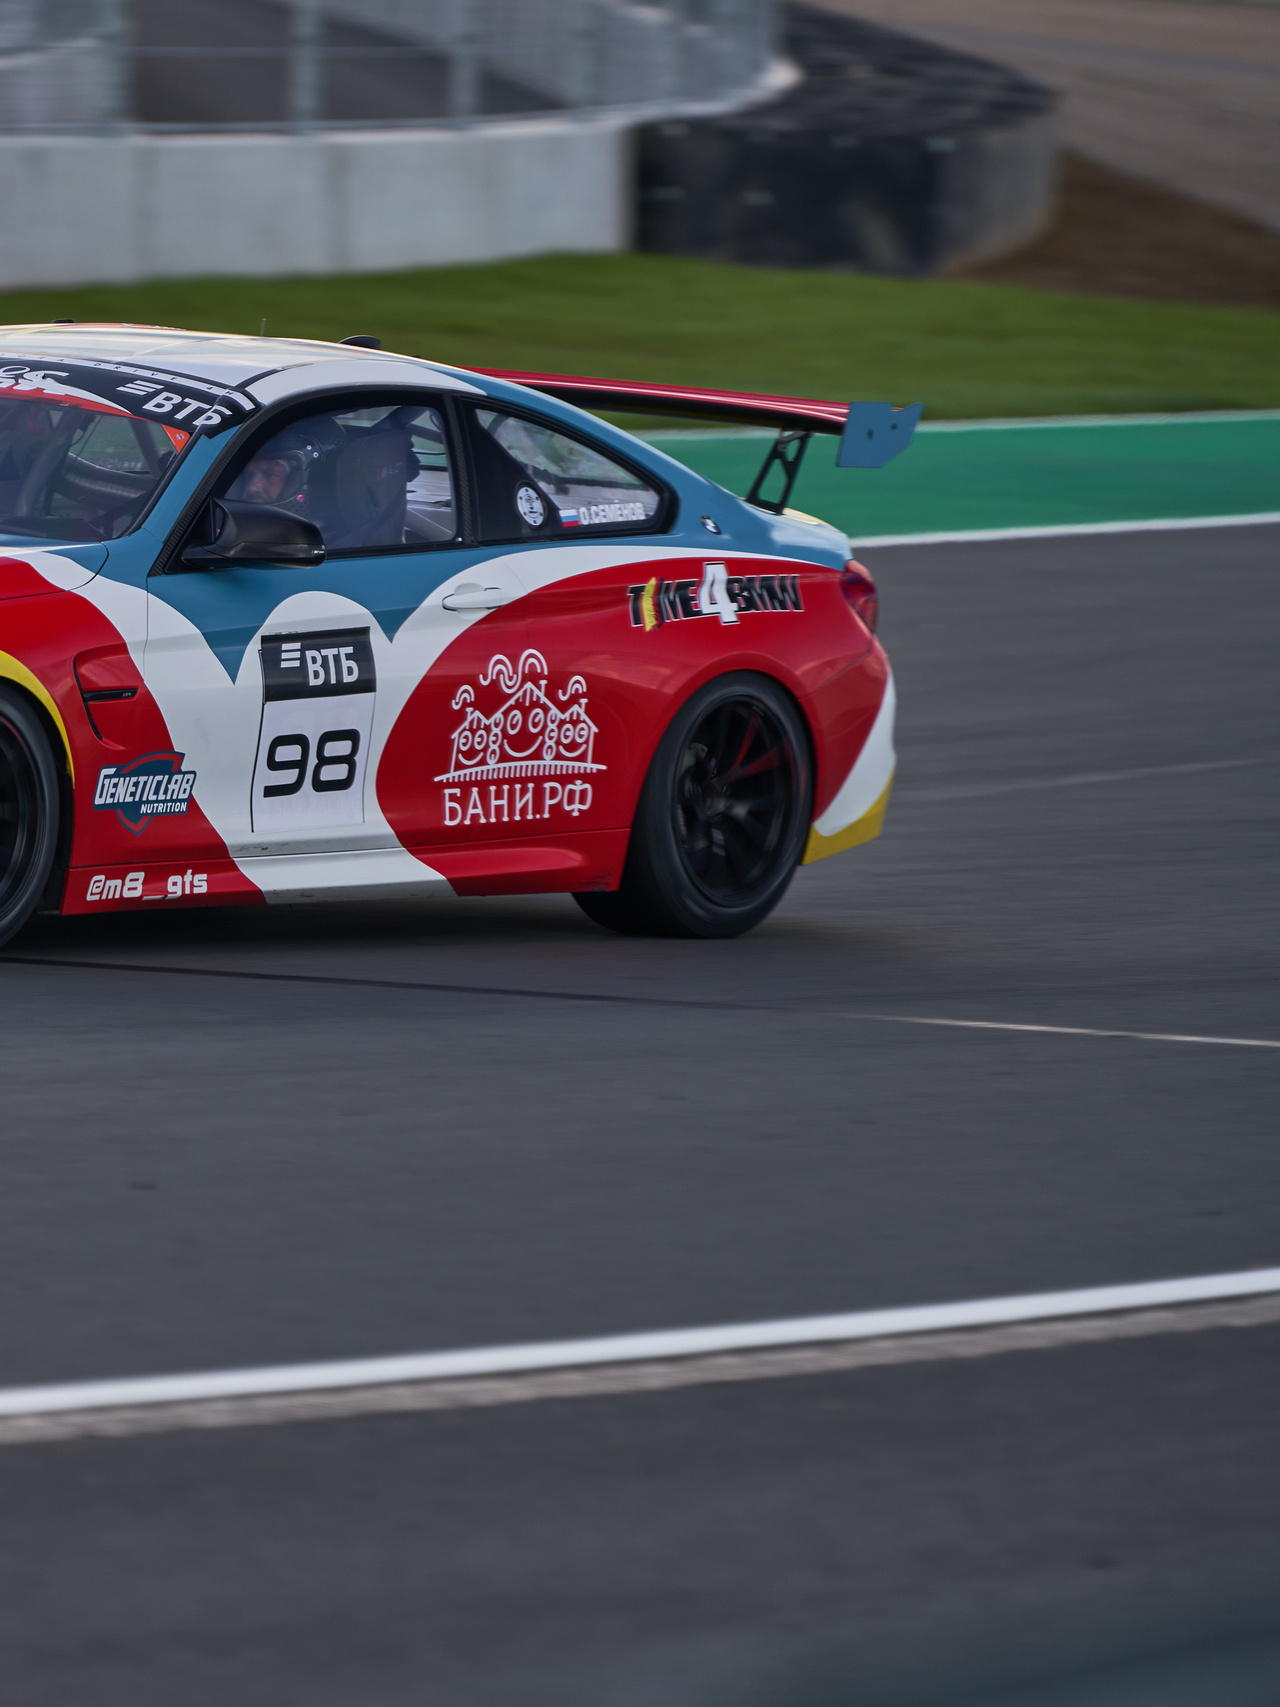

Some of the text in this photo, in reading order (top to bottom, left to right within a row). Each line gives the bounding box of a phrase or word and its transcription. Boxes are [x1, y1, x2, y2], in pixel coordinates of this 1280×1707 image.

[142, 391, 232, 426] ВТБ
[305, 646, 360, 686] ВТБ
[263, 728, 361, 798] 98
[94, 767, 195, 806] GENETICLAB
[443, 780, 593, 826] БАНИ.РФ
[140, 802, 188, 814] NUTRITION
